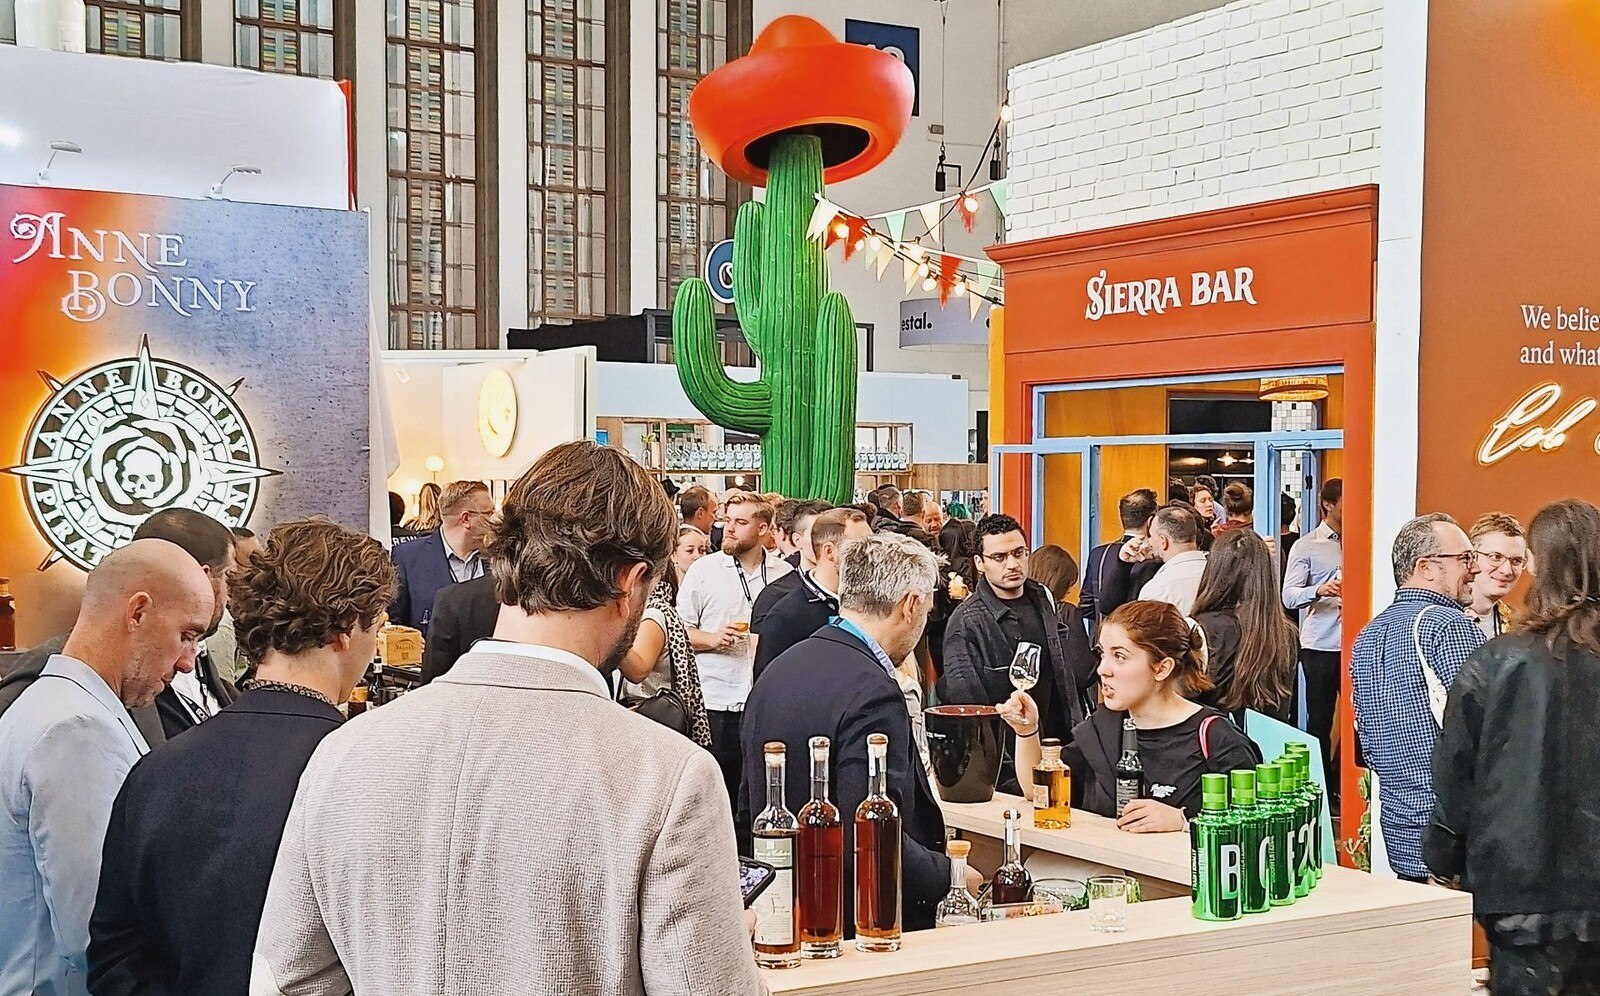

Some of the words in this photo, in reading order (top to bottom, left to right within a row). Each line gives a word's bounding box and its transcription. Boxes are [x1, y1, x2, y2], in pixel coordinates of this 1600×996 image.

[9, 211, 187, 274] ANNE
[60, 270, 256, 322] BONNY
[1085, 268, 1182, 322] SIERRA
[1190, 266, 1258, 307] BAR
[1520, 304, 1552, 330] We
[1556, 305, 1600, 332] belie
[1520, 340, 1555, 365] and
[38, 369, 126, 452] ANNE
[163, 370, 250, 456] BONNY
[35, 487, 112, 567] PIRAT
